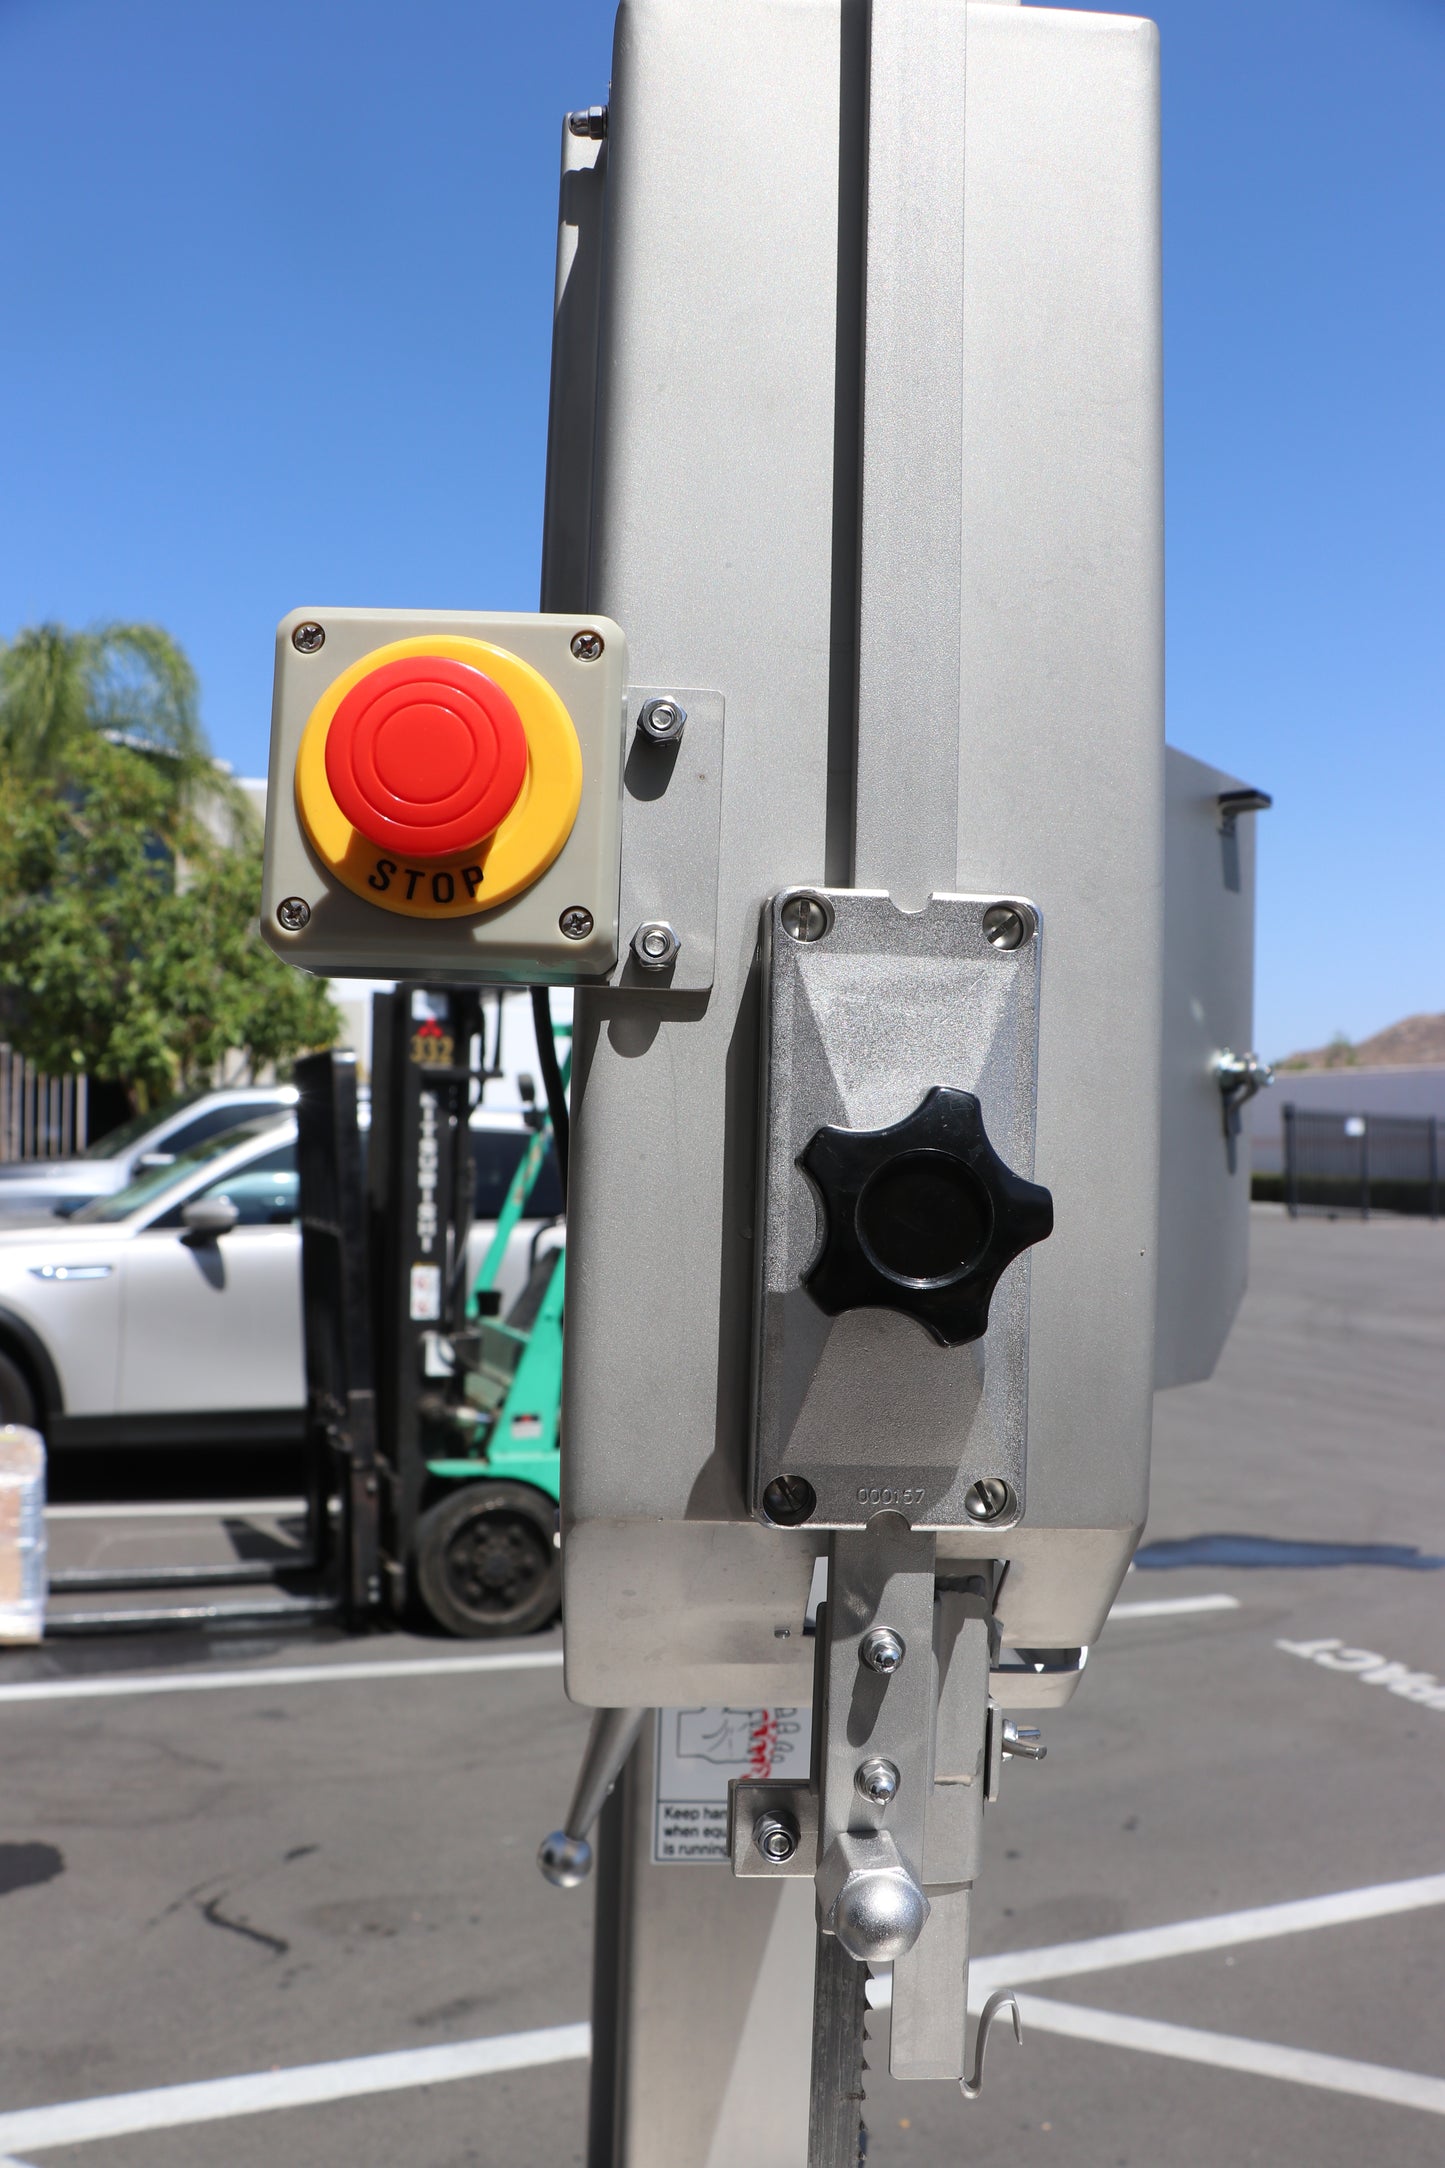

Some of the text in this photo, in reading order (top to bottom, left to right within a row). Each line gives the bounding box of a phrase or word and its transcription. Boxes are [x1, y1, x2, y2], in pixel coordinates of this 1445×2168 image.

[368, 859, 484, 903] STOP
[857, 1487, 926, 1505] 000157
[664, 1806, 727, 1821] Keep han
[664, 1824, 700, 1838] when
[663, 1841, 675, 1856] is
